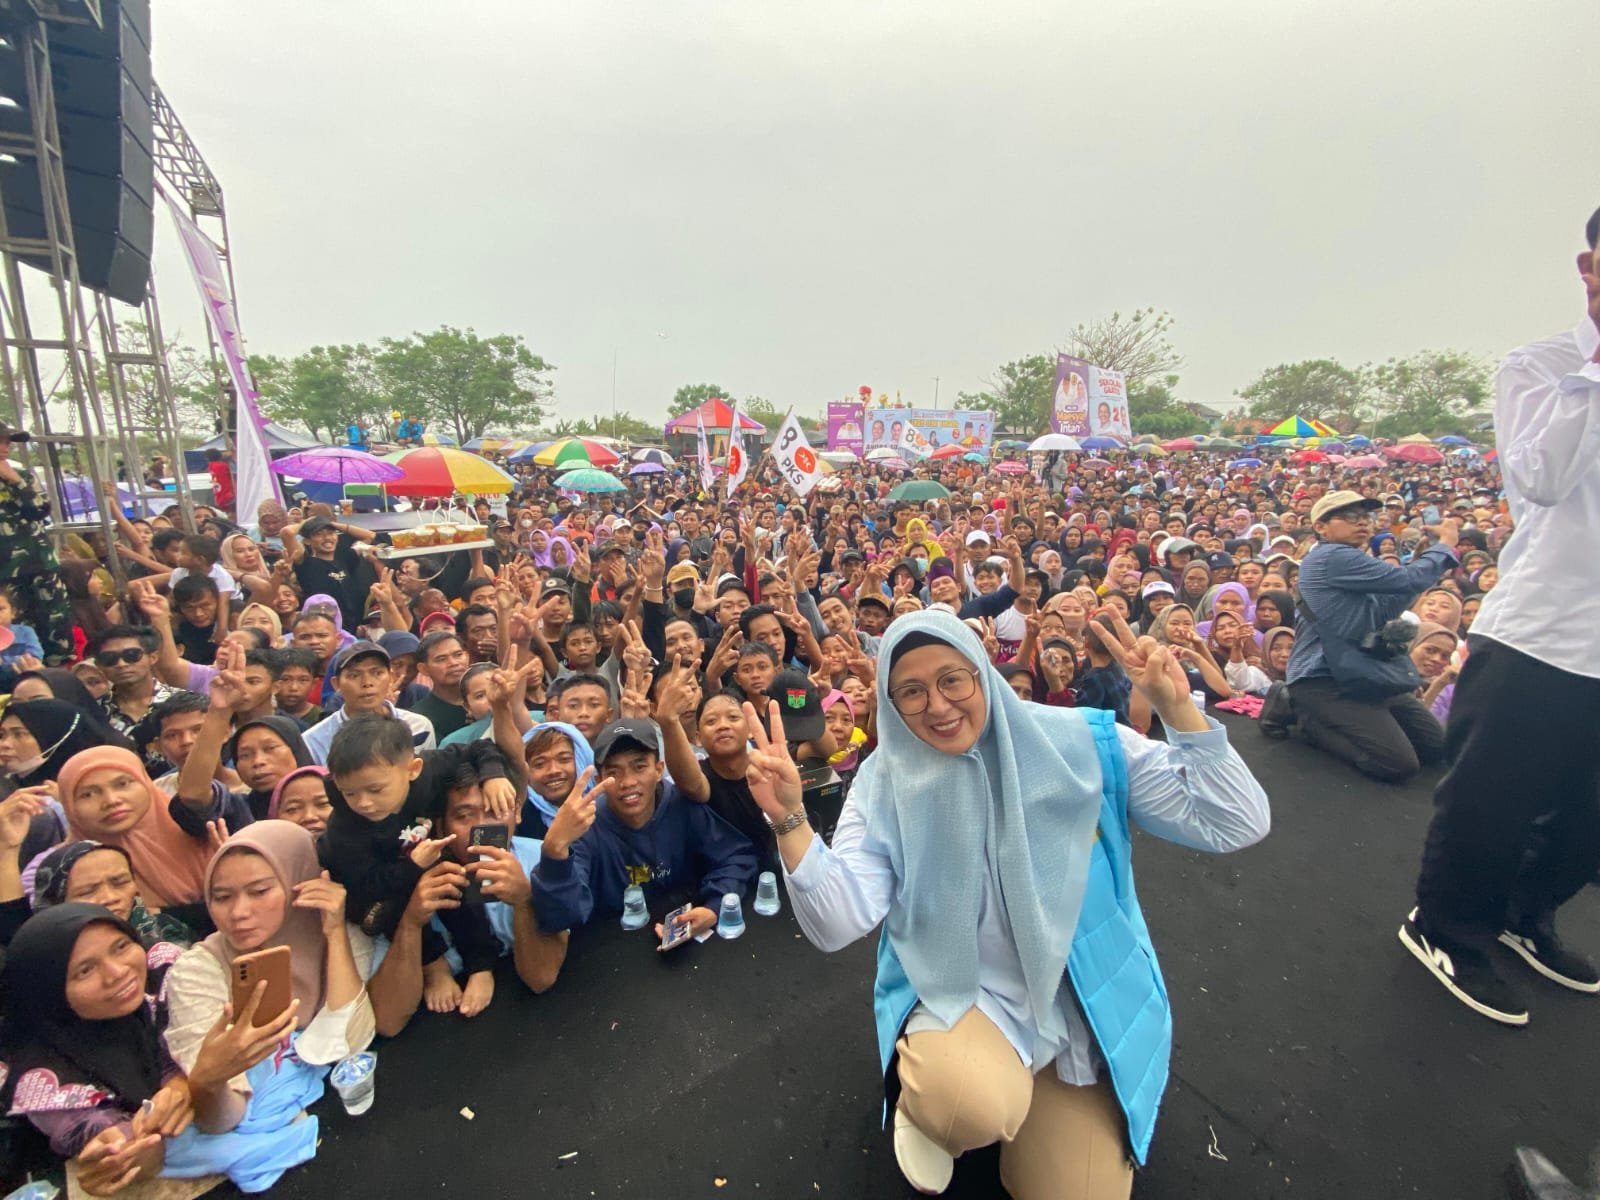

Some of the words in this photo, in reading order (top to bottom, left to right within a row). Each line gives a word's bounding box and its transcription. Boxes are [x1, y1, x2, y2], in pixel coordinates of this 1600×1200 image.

[905, 428, 916, 443] 8
[1060, 423, 1081, 433] Intan
[780, 426, 798, 450] 8
[781, 457, 805, 485] PKS
